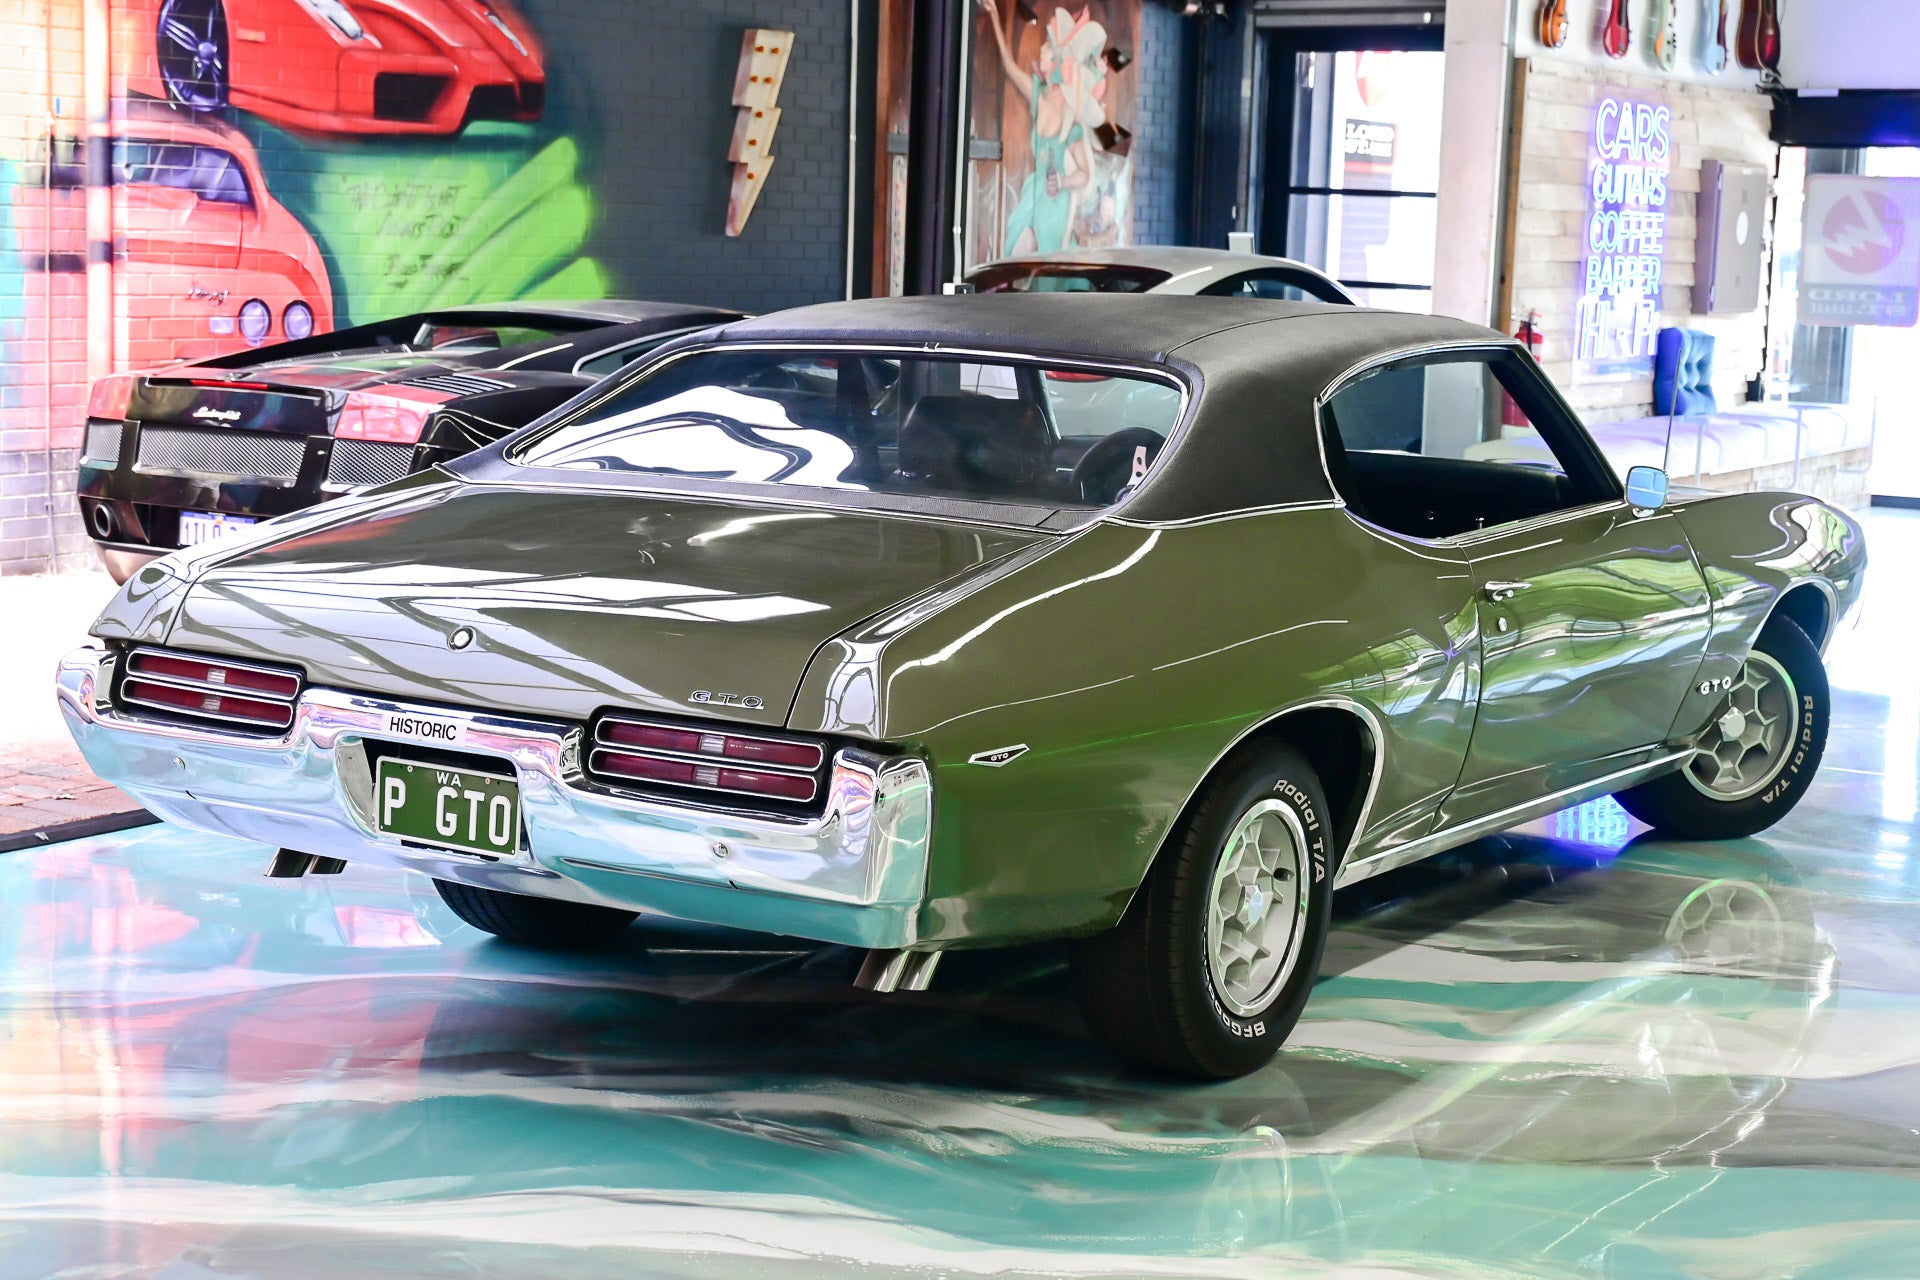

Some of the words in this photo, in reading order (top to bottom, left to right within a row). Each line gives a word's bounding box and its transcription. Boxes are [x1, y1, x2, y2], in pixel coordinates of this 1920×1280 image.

[1595, 98, 1670, 163] CARS
[1592, 162, 1668, 206] GUITARS
[1589, 209, 1665, 255] COFFEE
[1585, 254, 1661, 296] BARBER
[688, 689, 764, 709] GTO
[1696, 676, 1732, 695] GTO
[389, 716, 457, 741] HISTORIC
[1790, 695, 1814, 774] Radial
[990, 752, 1009, 762] GTO
[436, 770, 462, 788] WA
[1761, 779, 1791, 804] T/A
[383, 776, 406, 826] P
[435, 786, 512, 846] GTO
[1272, 779, 1320, 831] Radial
[1312, 836, 1326, 884] T/A
